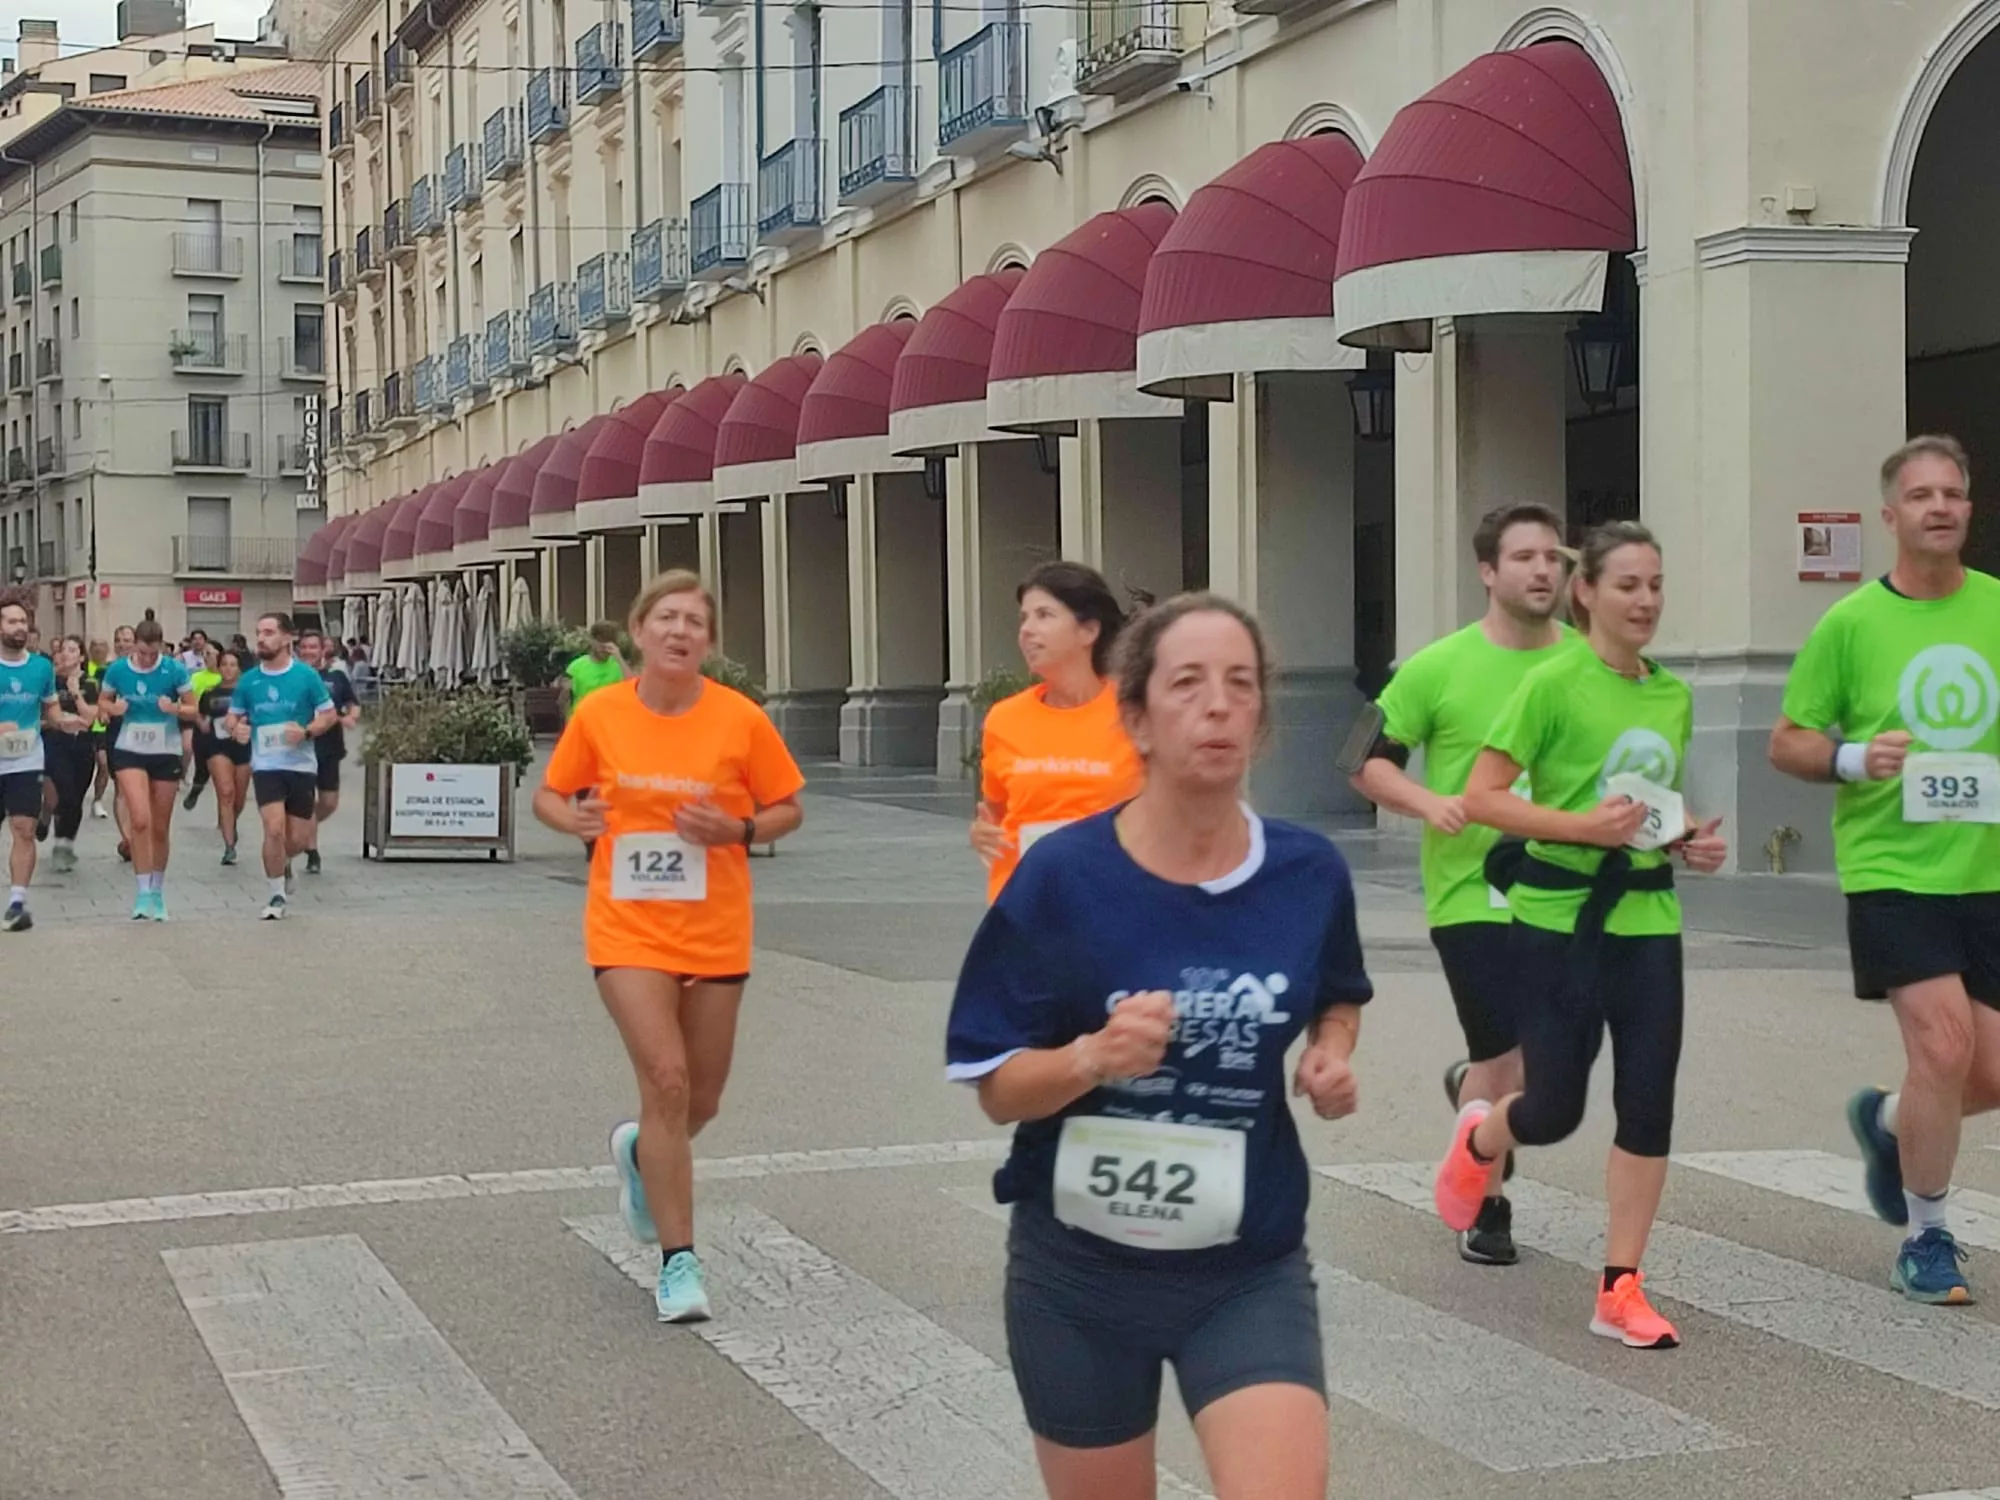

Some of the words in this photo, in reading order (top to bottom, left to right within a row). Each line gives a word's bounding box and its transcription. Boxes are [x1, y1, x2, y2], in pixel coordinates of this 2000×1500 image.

[305, 394, 319, 491] HOSTAL
[199, 592, 227, 602] GAES
[1920, 775, 1979, 798] 393
[405, 796, 430, 805] ZONA
[1926, 799, 1979, 809] IGNACIO
[628, 851, 684, 872] 122
[631, 873, 687, 882] YOLANDA
[1087, 1154, 1197, 1205] 542
[1108, 1200, 1184, 1222] ELENA
